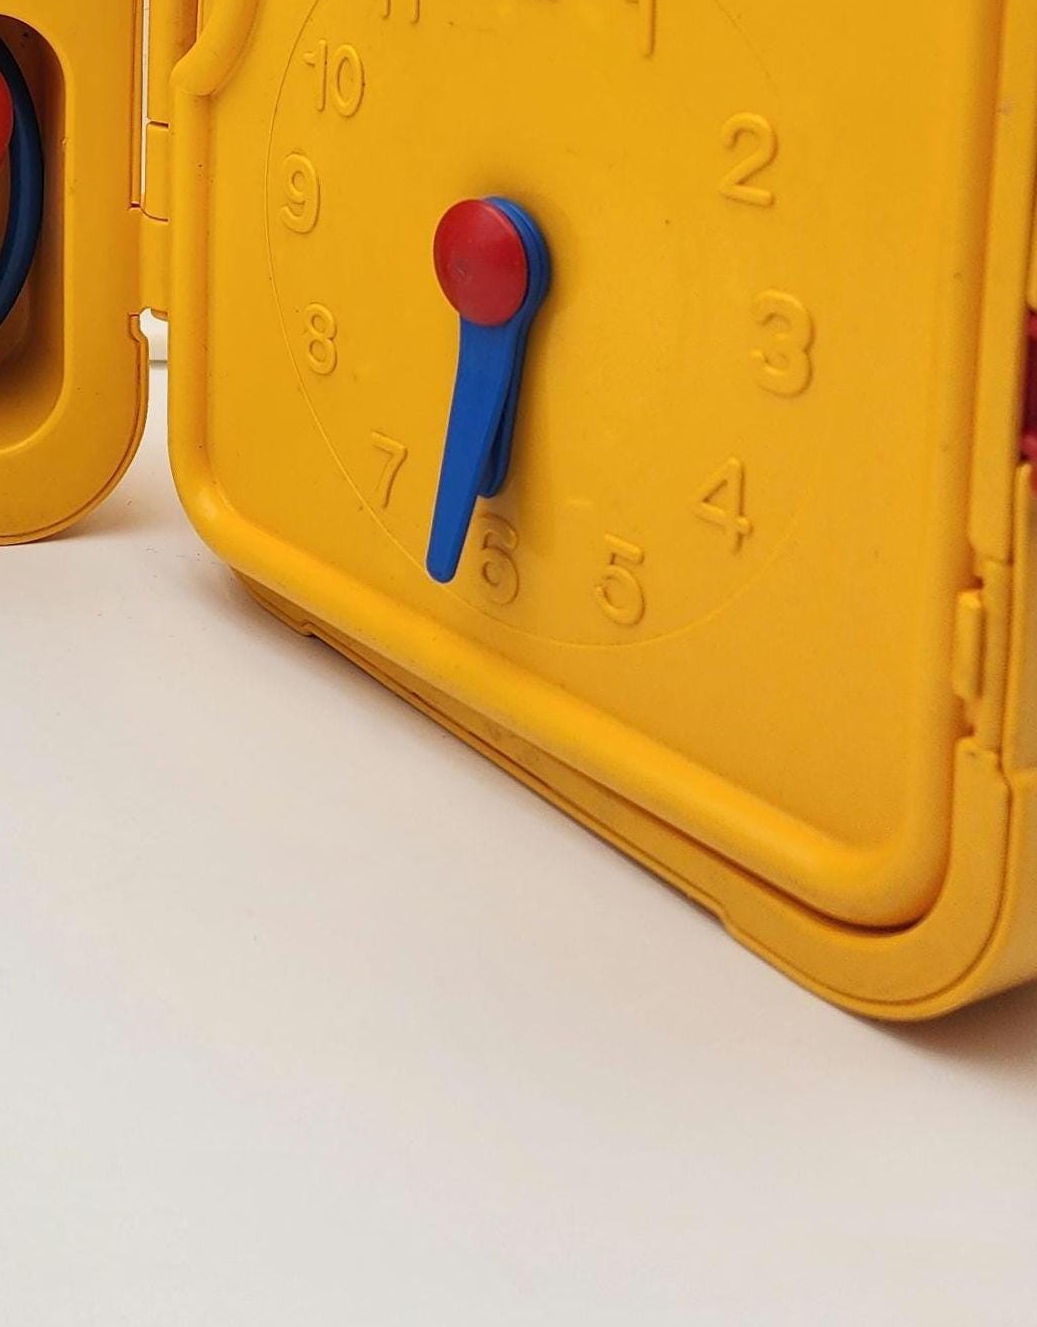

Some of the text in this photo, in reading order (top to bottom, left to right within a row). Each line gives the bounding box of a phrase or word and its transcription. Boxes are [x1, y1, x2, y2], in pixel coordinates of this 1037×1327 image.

[303, 39, 365, 117] 10
[279, 151, 321, 234] 9
[719, 111, 778, 207] 2
[304, 302, 339, 376] 8
[750, 289, 814, 398] 3
[371, 431, 408, 509] 7
[694, 457, 754, 553] 4
[476, 514, 520, 606] 6
[594, 534, 645, 627] 5
